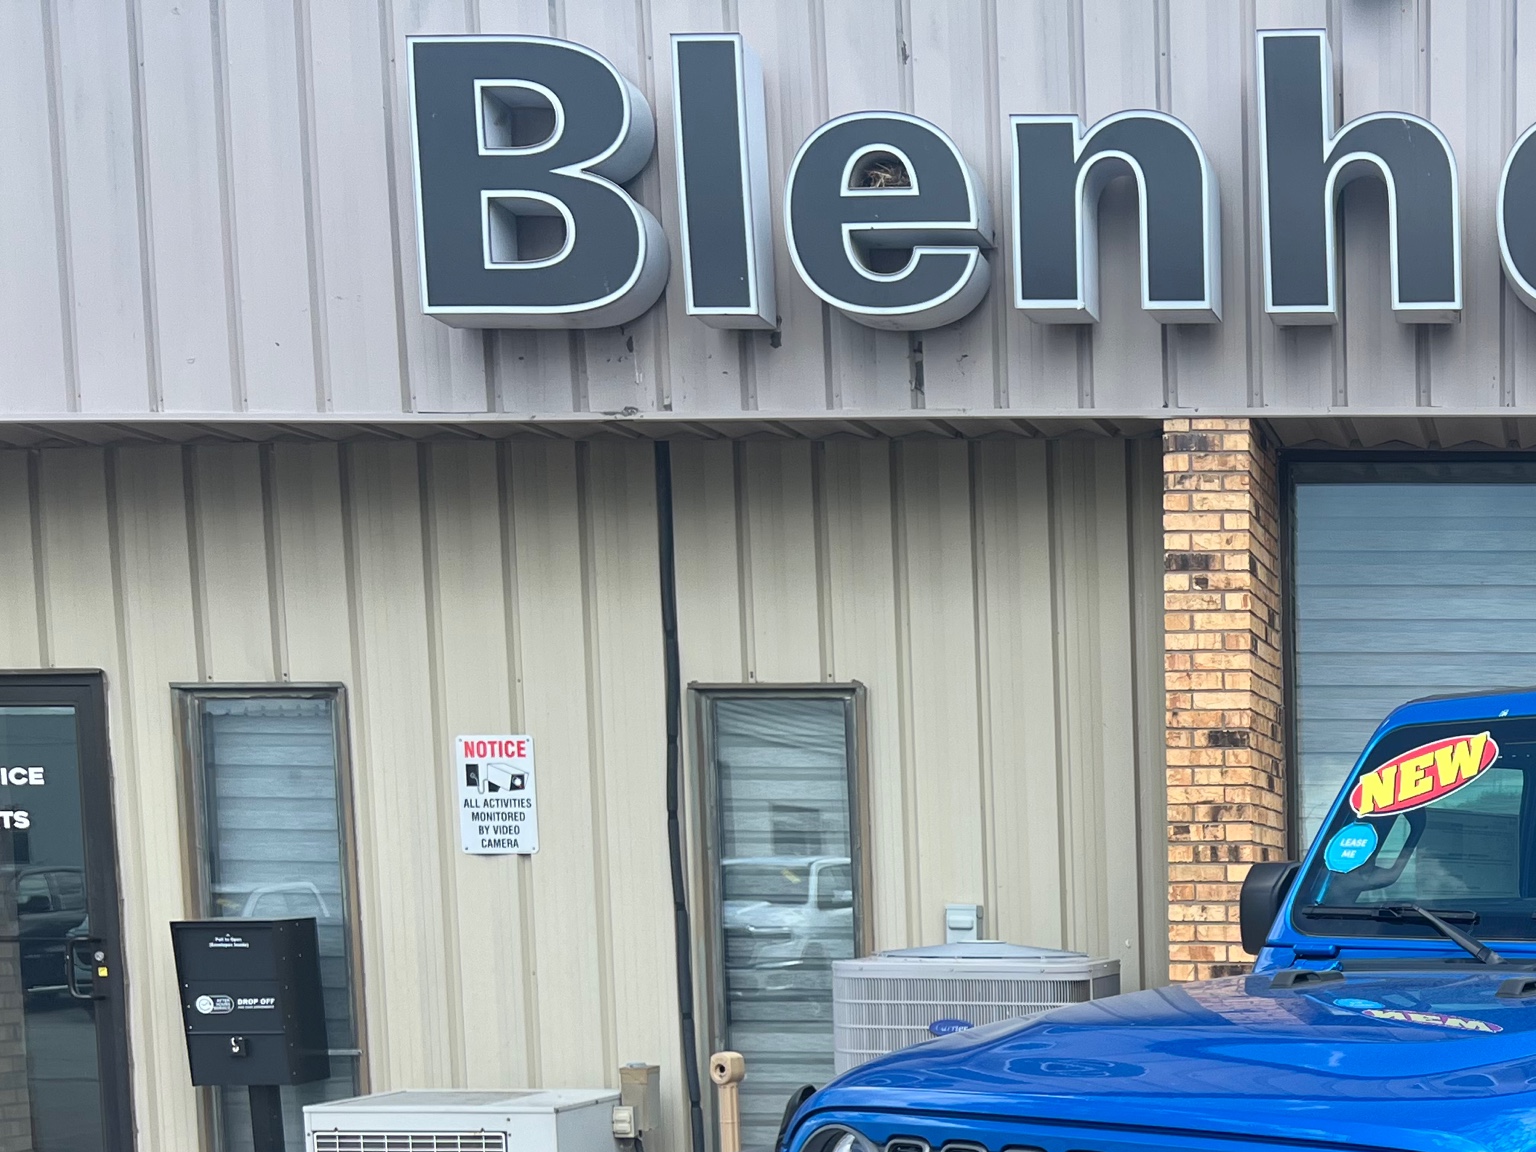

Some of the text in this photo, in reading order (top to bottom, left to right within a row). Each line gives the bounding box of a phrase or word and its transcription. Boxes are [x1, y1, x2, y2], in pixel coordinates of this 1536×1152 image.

[464, 740, 526, 758] NOTICE
[1359, 733, 1487, 815] NEW
[463, 798, 532, 809] ALL ACTIVITIES
[0, 810, 31, 830] TS
[471, 811, 526, 822] MONITORED
[478, 825, 520, 835] BY VIDEO
[481, 838, 519, 849] CAMERA
[1340, 838, 1368, 847] LEASE
[1341, 849, 1357, 858] ME
